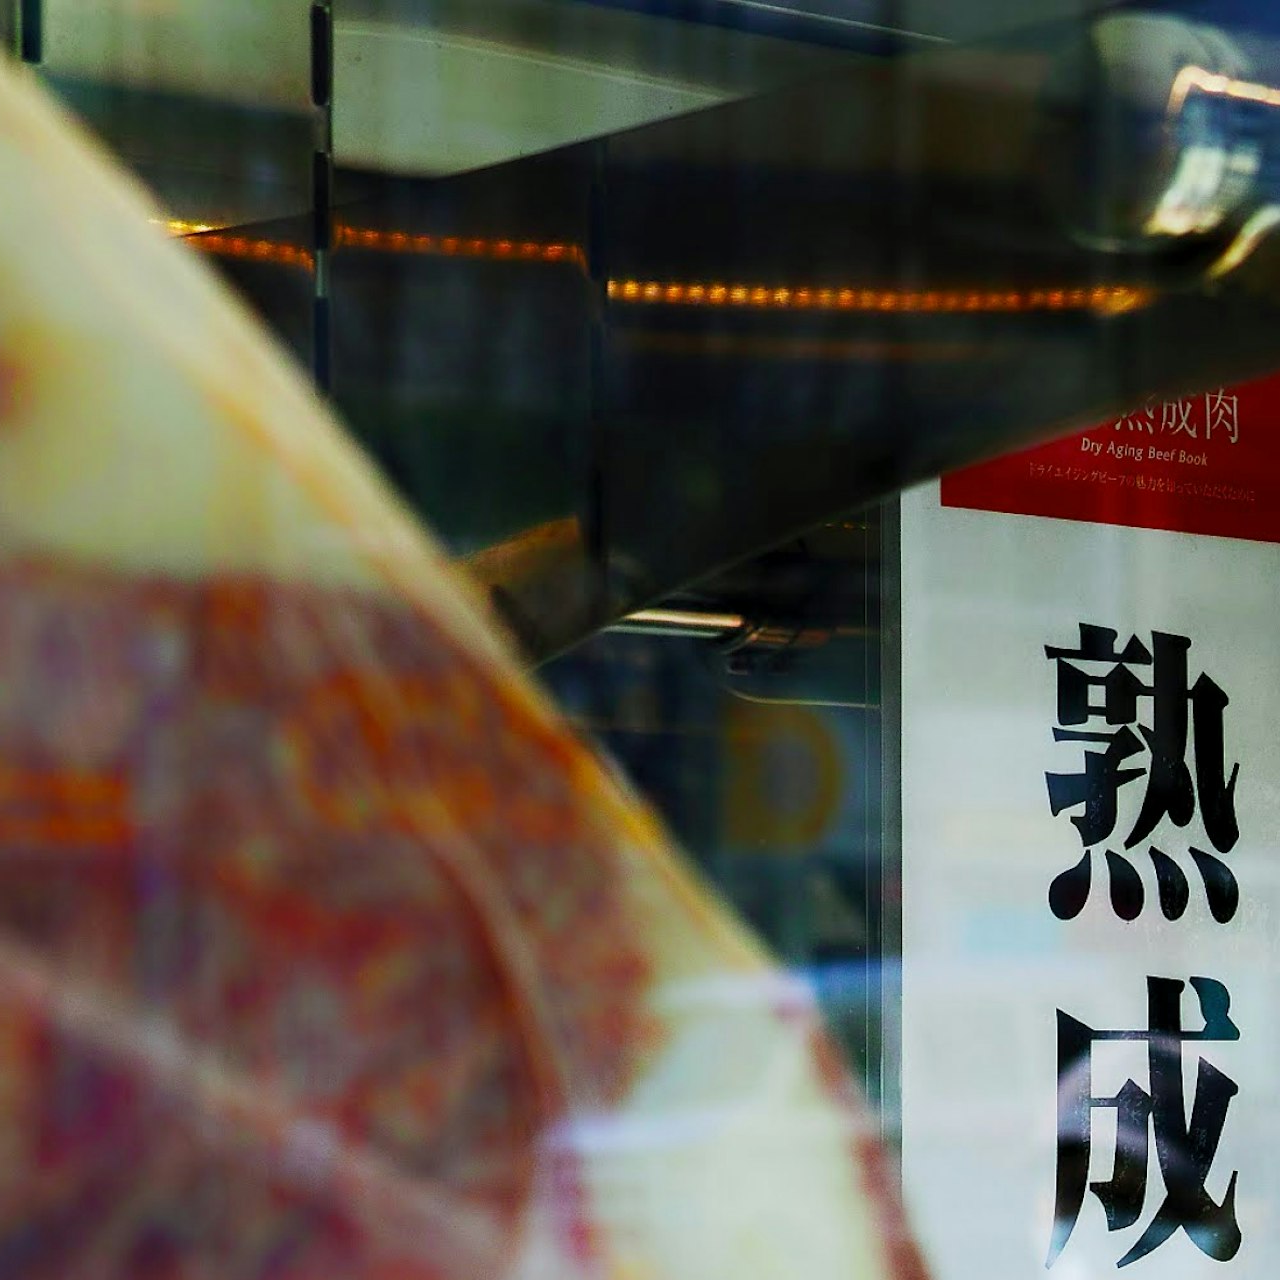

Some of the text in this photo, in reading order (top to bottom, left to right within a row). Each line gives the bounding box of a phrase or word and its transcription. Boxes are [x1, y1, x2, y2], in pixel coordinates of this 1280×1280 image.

[1080, 437, 1209, 467] Dry Aging Beef Book
